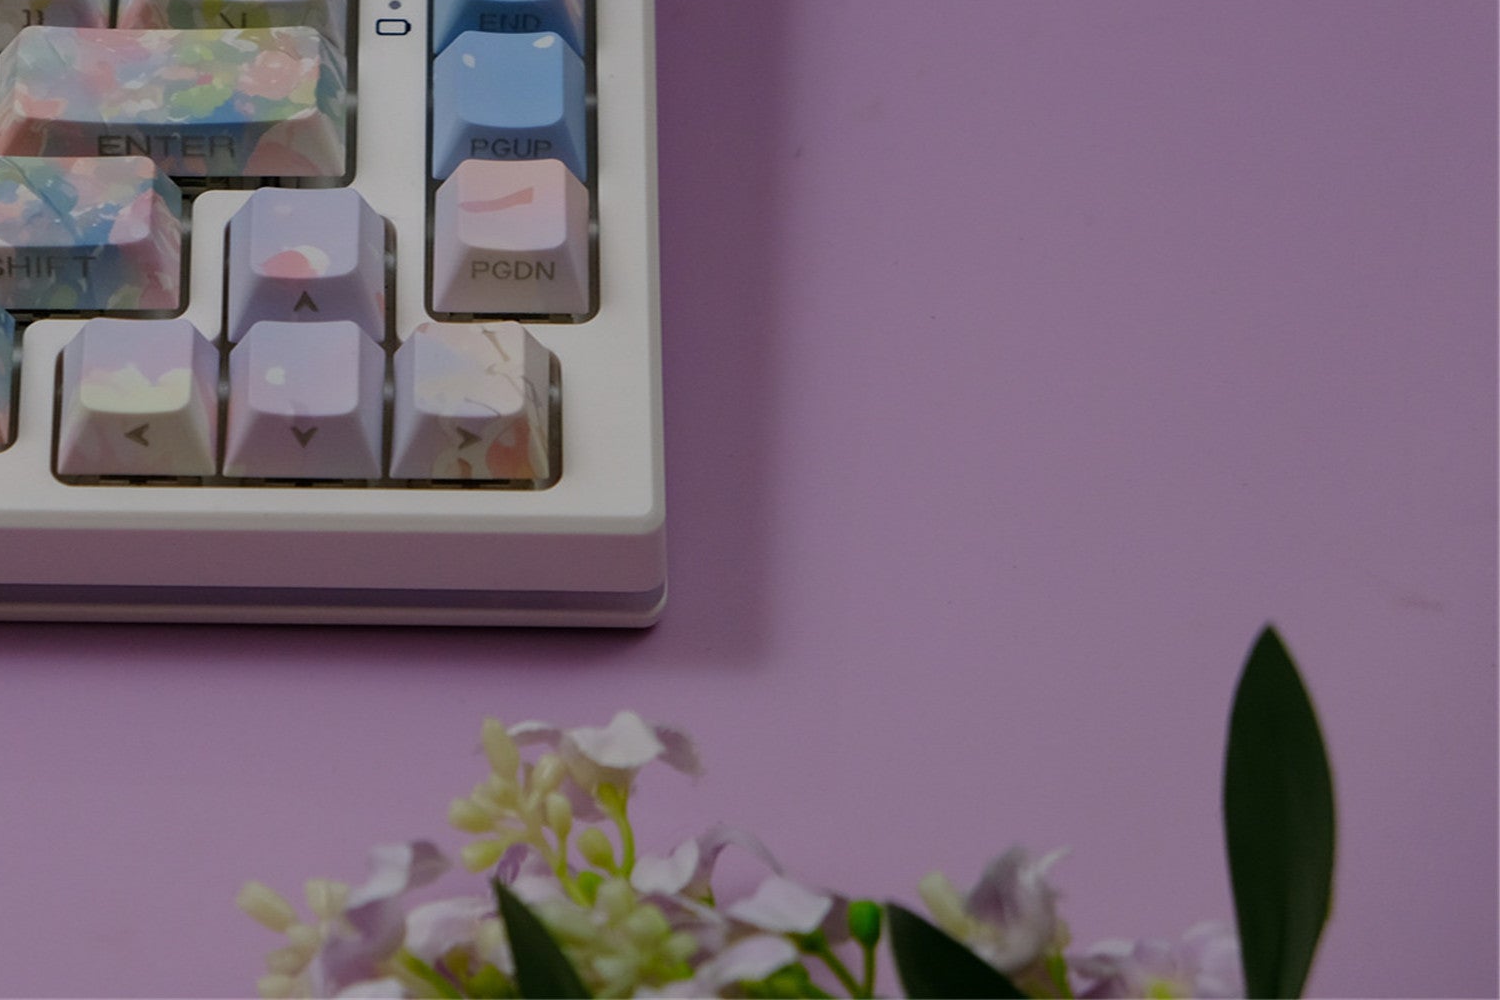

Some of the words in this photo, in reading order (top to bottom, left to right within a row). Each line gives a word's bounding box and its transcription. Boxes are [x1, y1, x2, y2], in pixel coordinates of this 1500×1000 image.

[480, 13, 541, 32] END
[97, 135, 236, 158] ENTER
[470, 138, 552, 159] PGUP
[471, 261, 556, 281] PGDN
